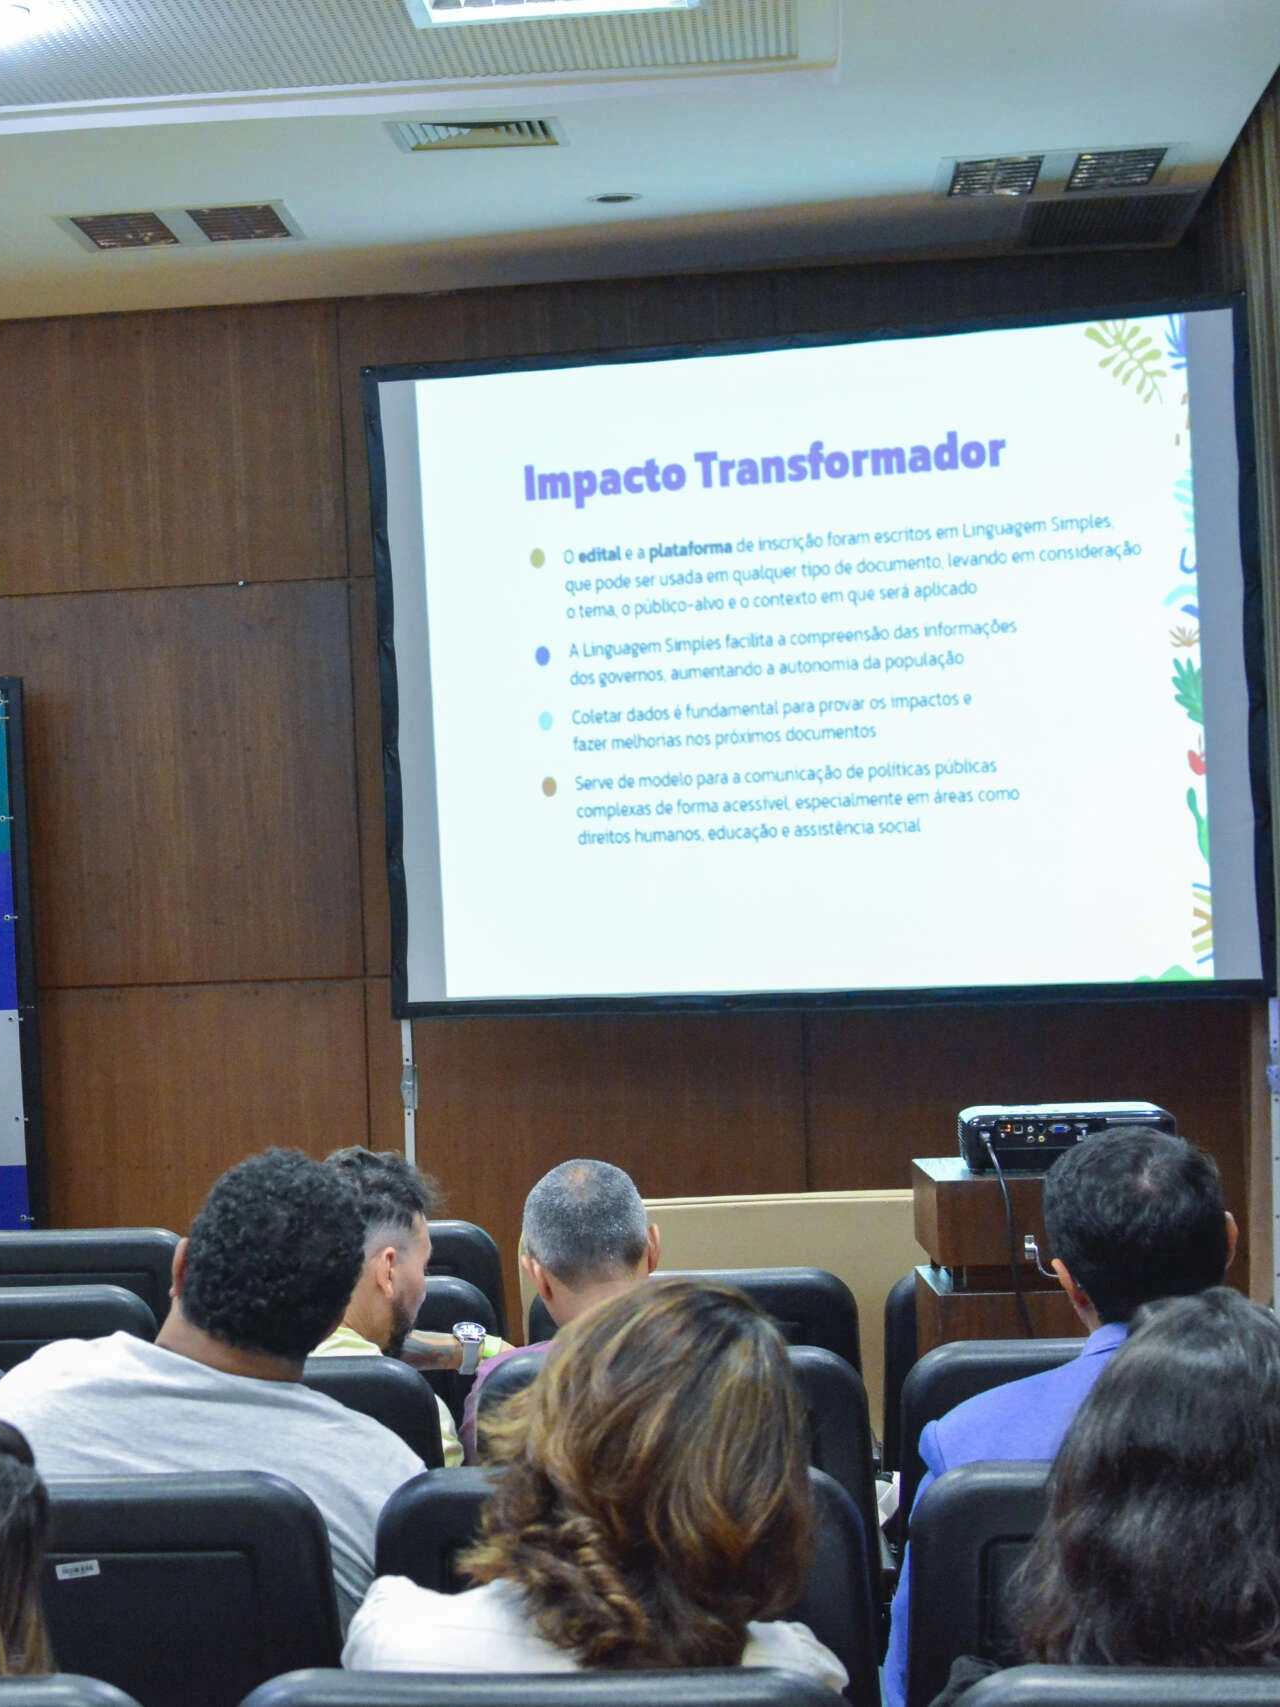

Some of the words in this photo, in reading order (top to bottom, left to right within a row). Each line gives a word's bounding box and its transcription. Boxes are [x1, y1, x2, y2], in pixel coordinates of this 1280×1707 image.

[524, 458, 687, 509] Impacto
[694, 430, 1007, 489] Transformador
[563, 549, 575, 565] O
[577, 545, 622, 564] edital
[624, 548, 634, 560] e
[636, 548, 646, 560] a
[648, 540, 733, 564] plataforma
[736, 537, 755, 553] de
[758, 533, 824, 553] inscrição
[827, 531, 871, 547] foram
[874, 528, 932, 544] escritos
[935, 527, 959, 540] em
[962, 521, 1047, 540] Linguagem
[565, 579, 592, 597] que
[594, 574, 632, 595] pode
[634, 575, 656, 588] ser
[659, 569, 704, 586] usada
[706, 570, 730, 583] em
[732, 565, 797, 586] qualquer
[801, 562, 831, 580] tipo
[834, 560, 853, 575] de
[947, 550, 1008, 568] levando
[1011, 551, 1035, 564] em
[1039, 540, 1142, 562] consideração
[566, 607, 576, 619] o
[621, 604, 631, 616] o
[634, 596, 725, 619] público-alvo
[728, 597, 737, 610] e
[739, 597, 750, 608] o
[753, 592, 818, 608] contexto
[820, 591, 844, 604] em
[847, 589, 876, 607] que
[879, 584, 910, 600] será
[914, 580, 978, 601] aplicado
[569, 643, 580, 658] A
[582, 641, 662, 660] Linguagem
[665, 636, 722, 656] Simples
[725, 632, 774, 649] facilita
[777, 634, 786, 646] a
[790, 625, 890, 648] compreensão
[893, 624, 920, 640] das
[924, 618, 1017, 639] informações
[569, 671, 596, 686] dos
[670, 661, 763, 680] aumentando
[766, 664, 775, 675] a
[778, 659, 859, 675] autonomia
[863, 655, 882, 670] da
[885, 650, 964, 672] população
[572, 708, 623, 725] Coletar
[626, 706, 671, 722] dados
[685, 700, 779, 719] fundamental
[782, 701, 815, 719] para
[818, 699, 866, 717] provar
[869, 697, 887, 710] os
[891, 693, 960, 712] impactos
[963, 693, 972, 705] e
[572, 736, 608, 752] fazer
[611, 734, 682, 750] melhorias
[685, 733, 712, 746] nos
[715, 729, 782, 749] próximos
[785, 725, 877, 742] documentos
[575, 776, 614, 791] Serve
[617, 774, 635, 789] de
[638, 772, 694, 788] modelo
[696, 772, 729, 790] para
[732, 772, 741, 784] a
[744, 764, 842, 784] comunicação
[846, 764, 864, 779] de
[868, 762, 931, 783] políticas
[935, 759, 998, 780] públicas
[576, 802, 653, 821] complexas
[655, 800, 674, 816] de
[676, 799, 720, 814] forma
[795, 792, 904, 813] especialmente
[906, 792, 930, 805] em
[933, 788, 974, 804] áreas
[978, 789, 1020, 802] como
[577, 830, 631, 846] direitos
[707, 823, 778, 843] educação
[781, 826, 791, 838] e
[793, 820, 875, 837] assistência
[878, 818, 921, 834] social
